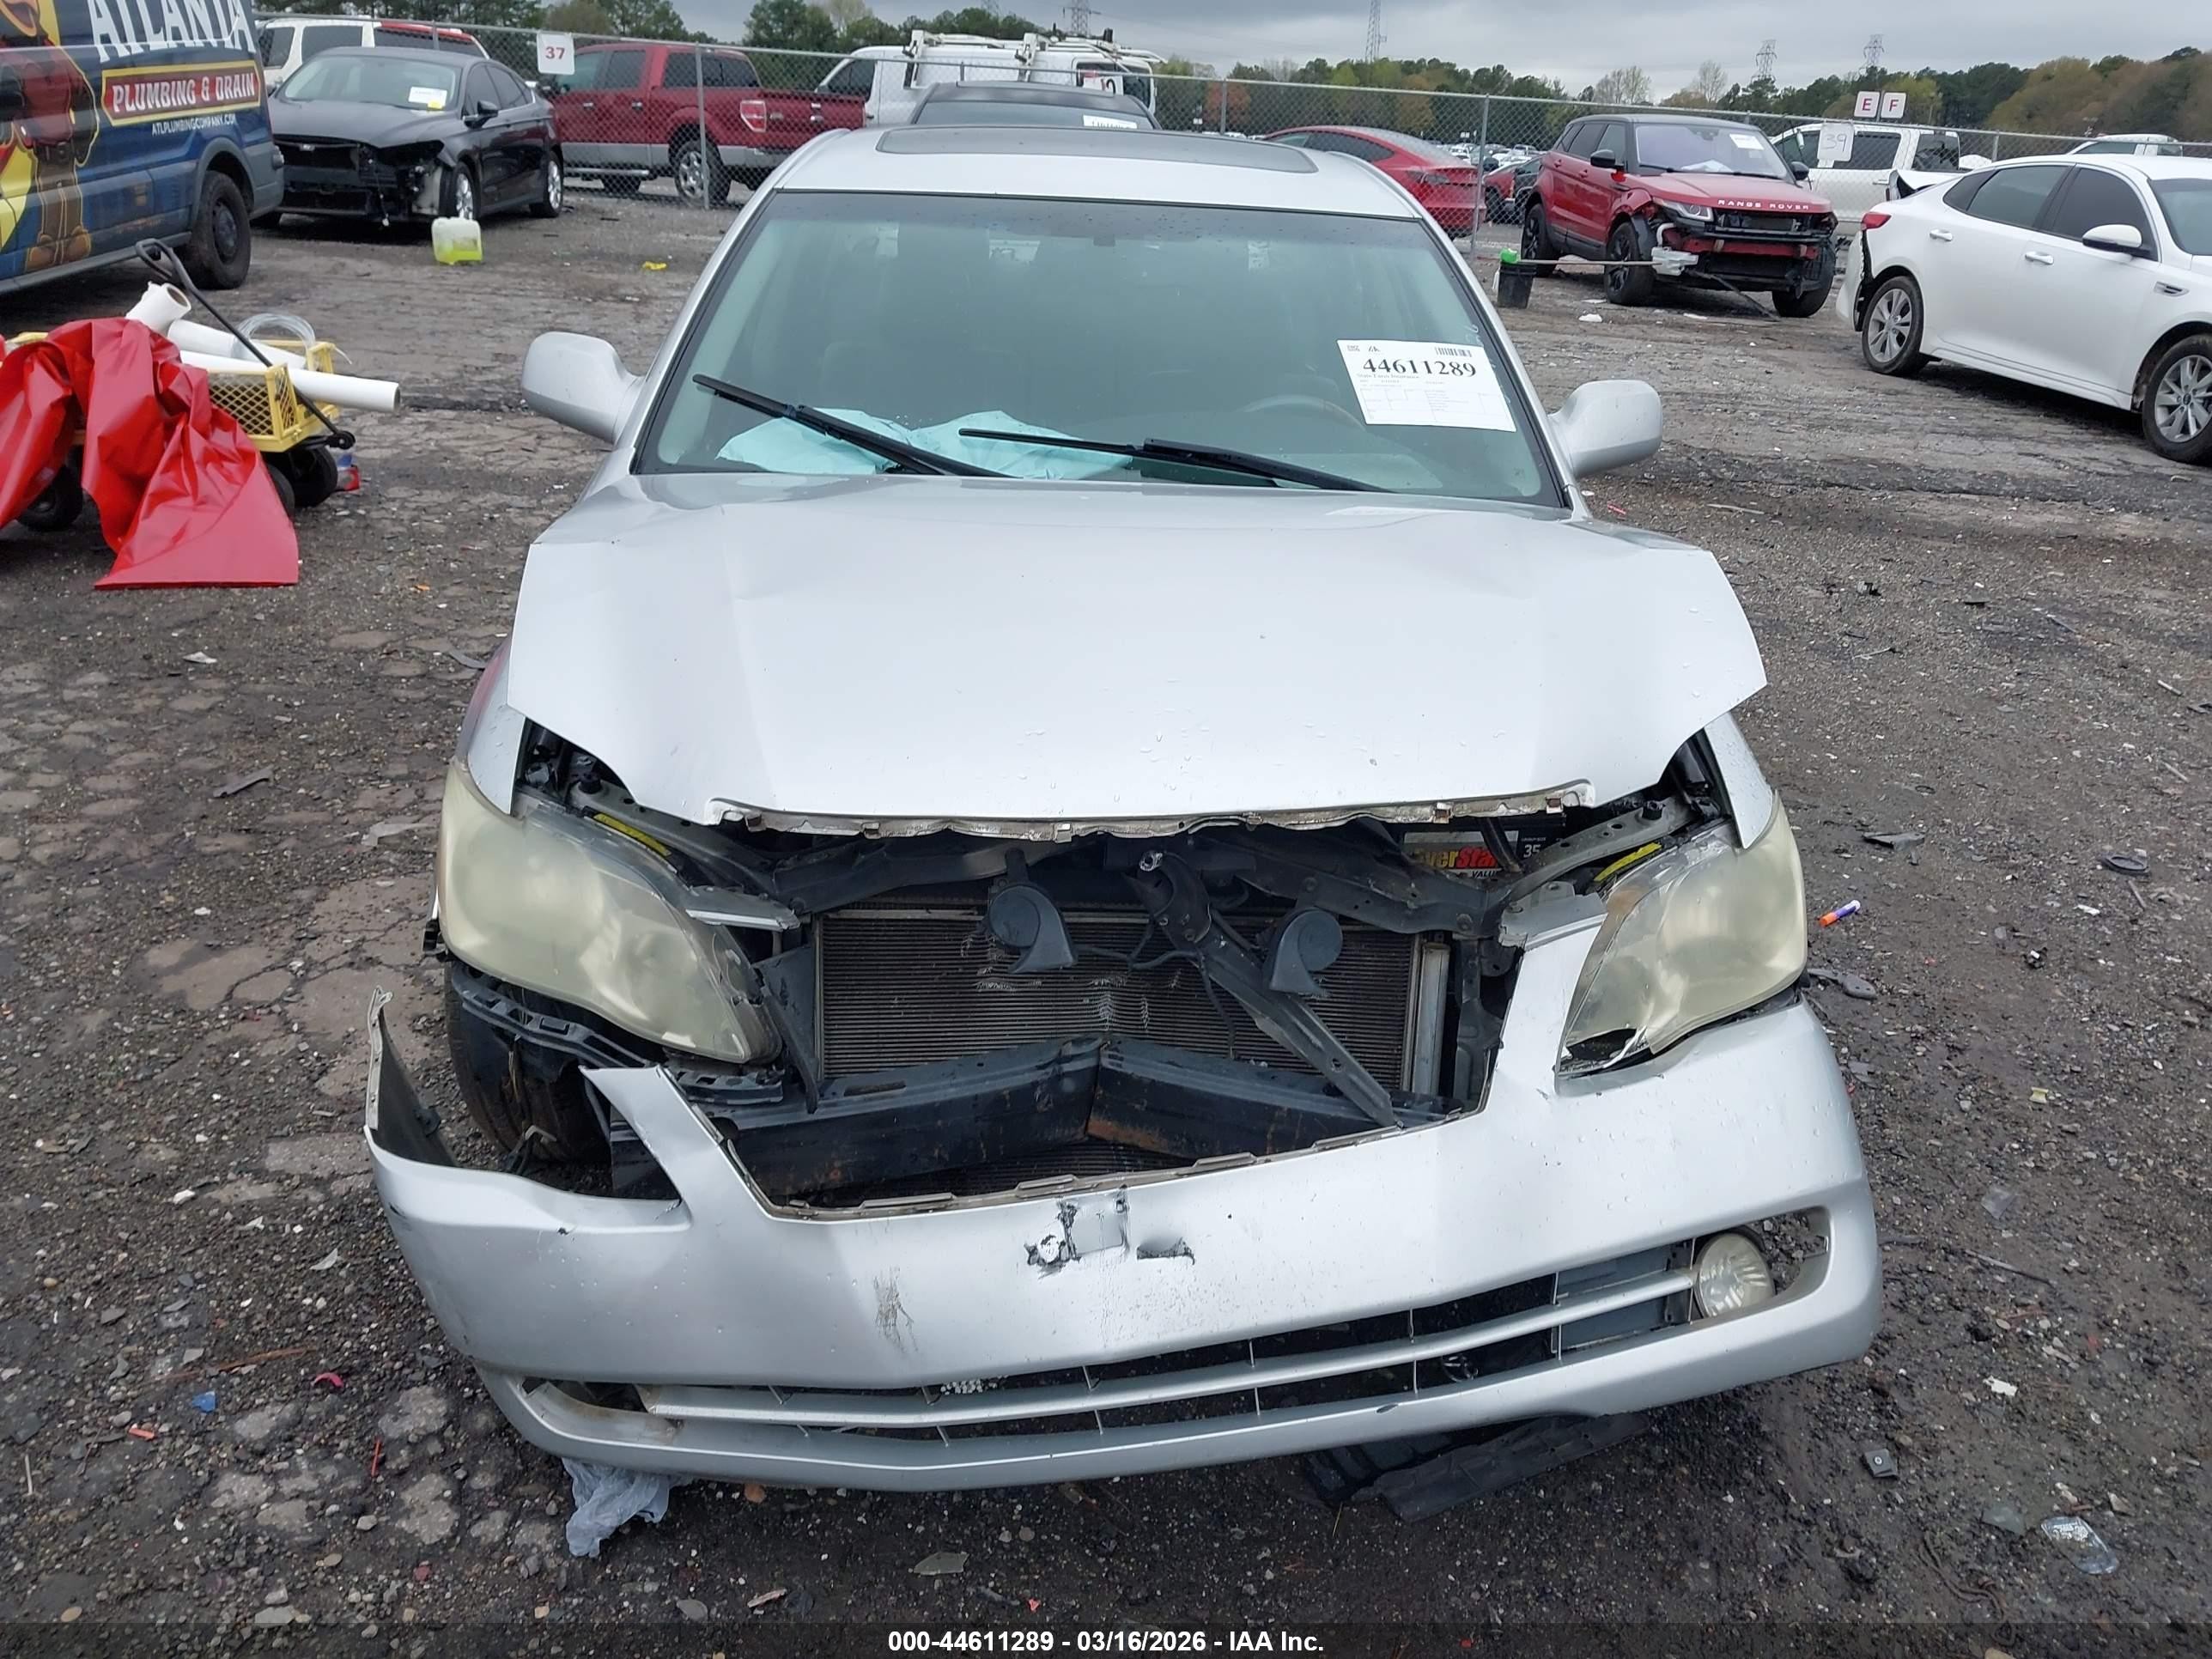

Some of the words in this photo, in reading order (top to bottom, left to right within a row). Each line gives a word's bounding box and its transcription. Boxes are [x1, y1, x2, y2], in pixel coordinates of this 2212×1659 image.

[88, 0, 256, 63] ATLANTA
[545, 46, 565, 59] 37
[112, 79, 195, 112] PLUMBING
[201, 76, 210, 100] &
[216, 72, 255, 100] DRAIN
[1862, 98, 1872, 112] E
[1889, 99, 1899, 112] F
[1824, 134, 1847, 152] 39
[1718, 199, 1761, 208] RANGE
[1363, 358, 1476, 377] 44611289
